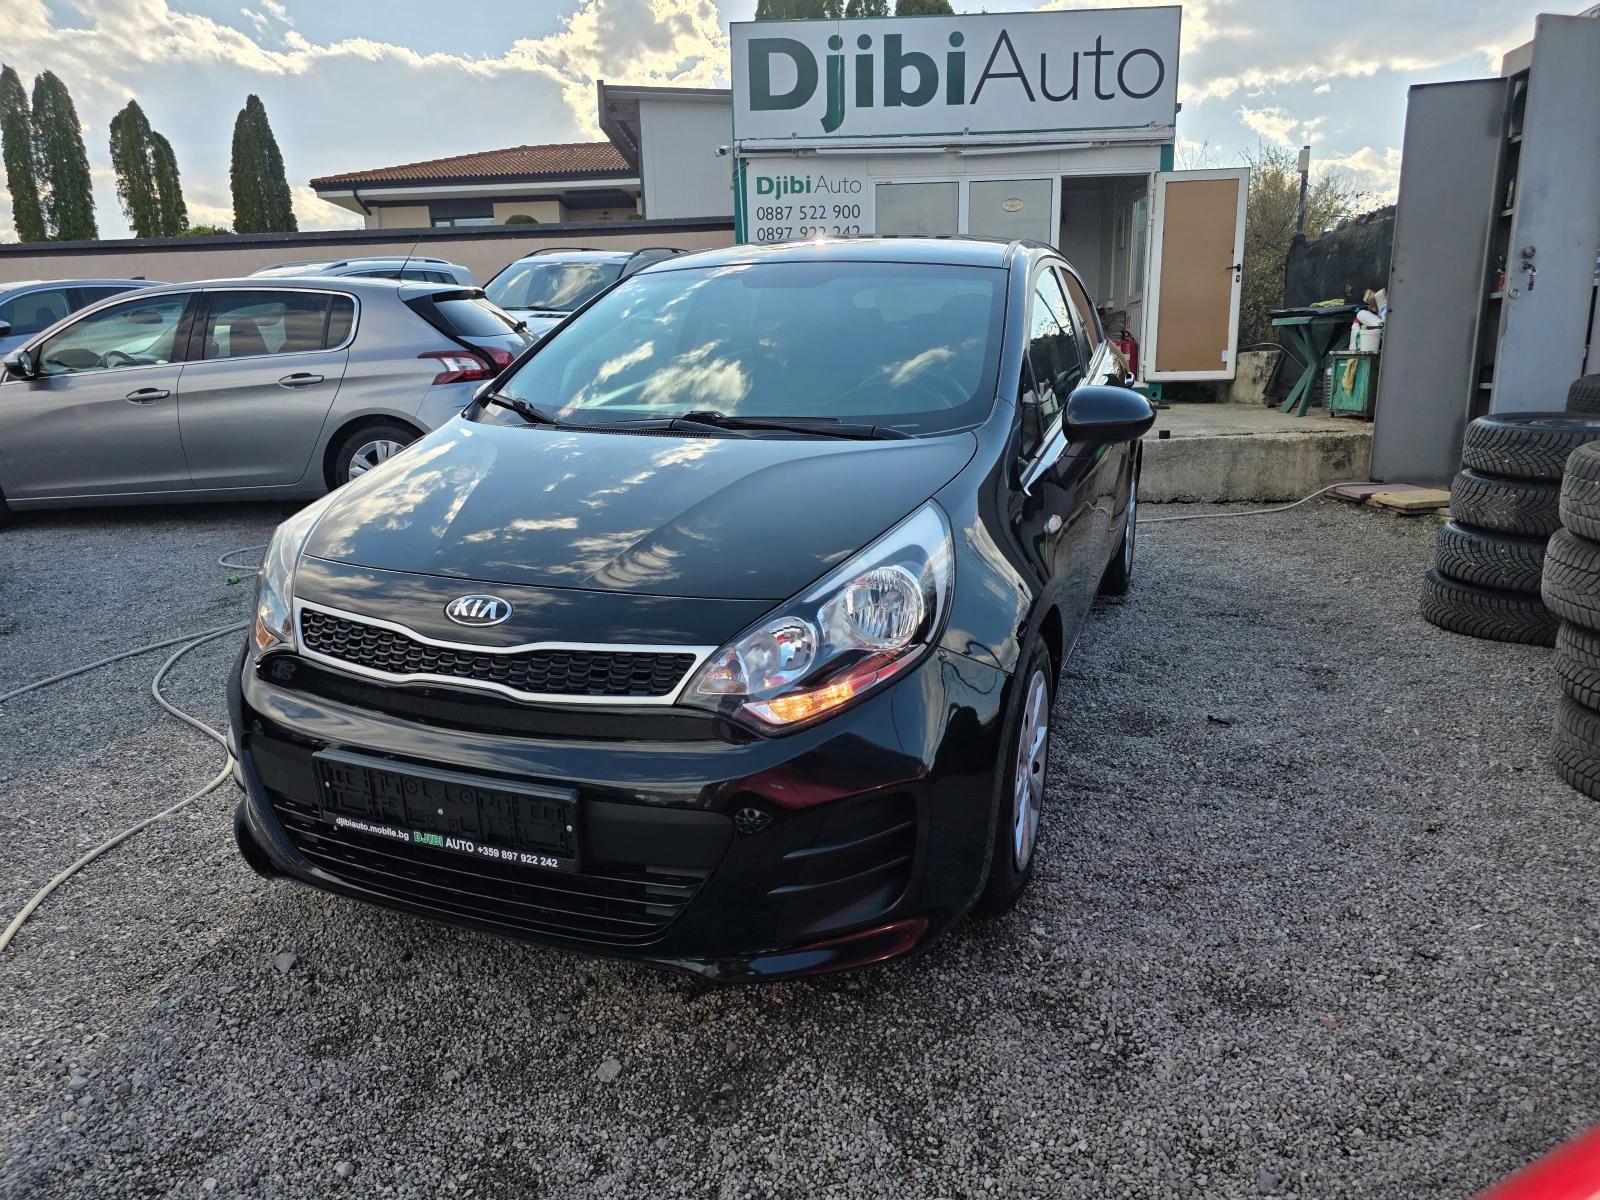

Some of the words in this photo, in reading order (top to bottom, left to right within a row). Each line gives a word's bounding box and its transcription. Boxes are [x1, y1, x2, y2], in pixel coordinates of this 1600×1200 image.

[756, 175, 811, 200] Djibi
[814, 174, 862, 194] Auto
[756, 206, 793, 221] 0887
[799, 205, 827, 220] 522
[833, 204, 861, 219] 900
[757, 227, 793, 241] 0897
[453, 598, 498, 620] KIA
[335, 816, 410, 842] djibiauto.mobile.bg
[445, 837, 475, 853] AUTO
[477, 846, 500, 858] +359
[501, 851, 519, 861] 897
[520, 853, 539, 865] 922
[540, 857, 559, 868] 242
